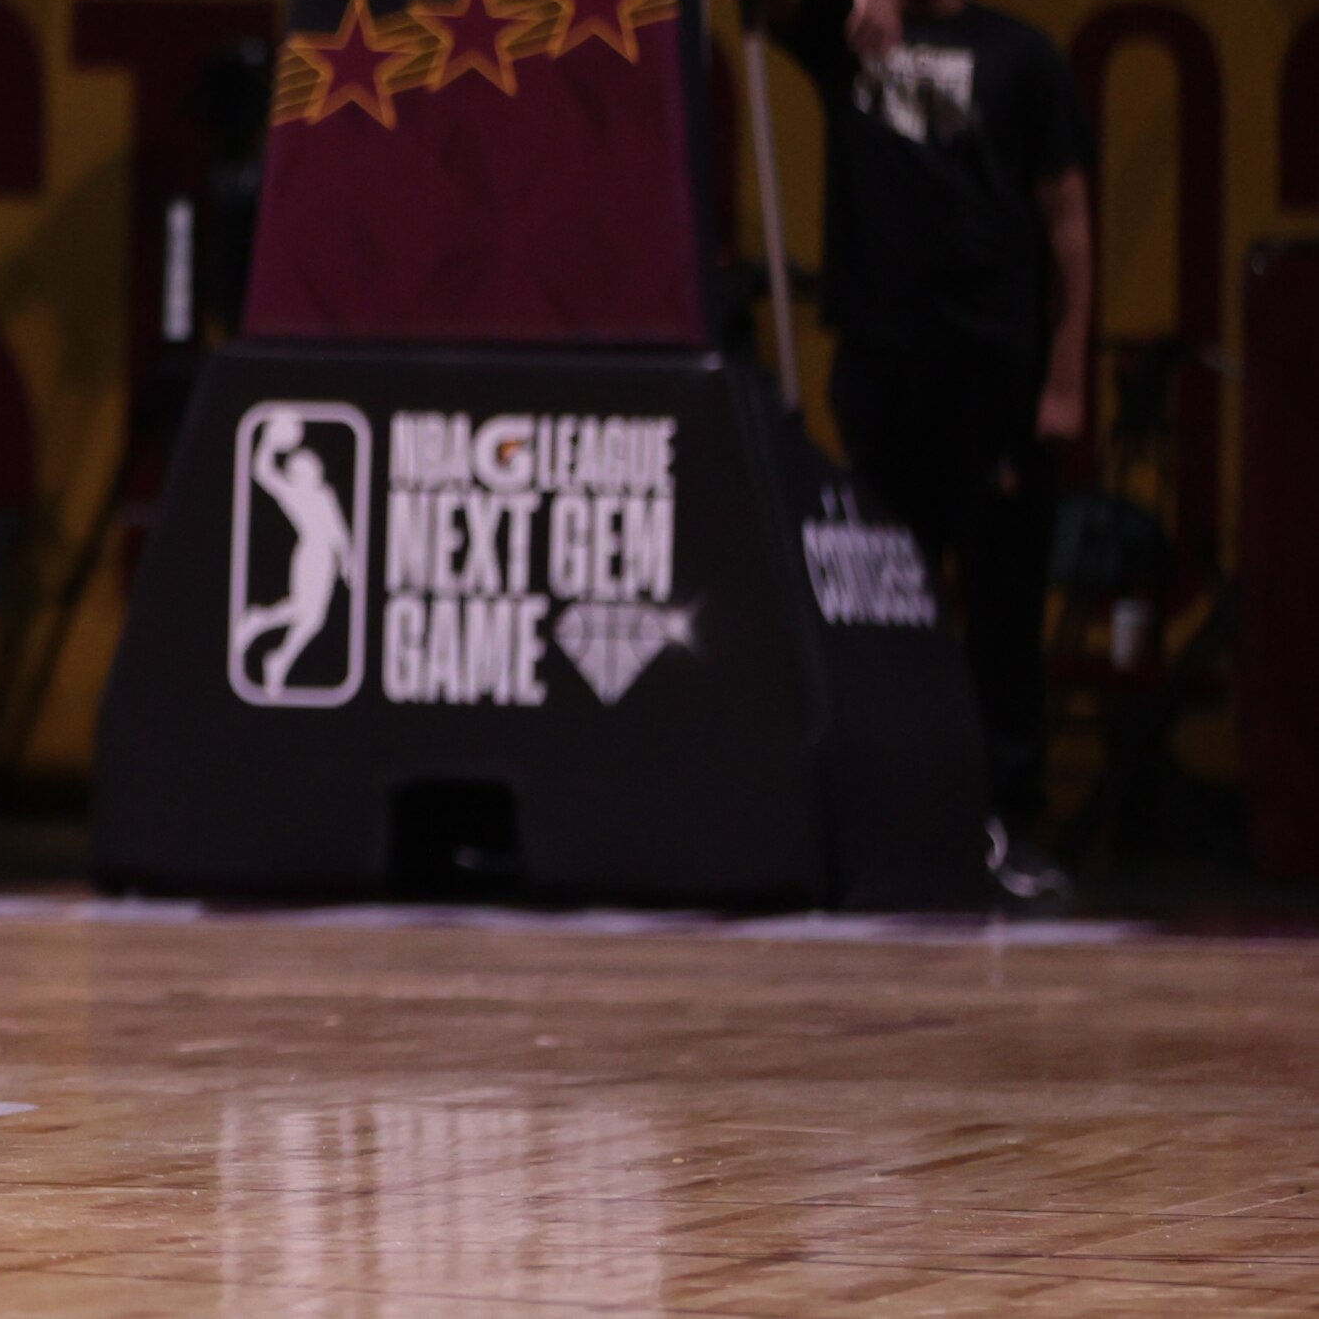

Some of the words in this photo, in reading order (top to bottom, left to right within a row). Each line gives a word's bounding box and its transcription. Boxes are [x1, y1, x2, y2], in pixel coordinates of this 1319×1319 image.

[535, 413, 679, 493] LEAGUE
[383, 488, 544, 596] NEXT
[547, 491, 676, 604] GEM
[381, 592, 551, 708] GAME
